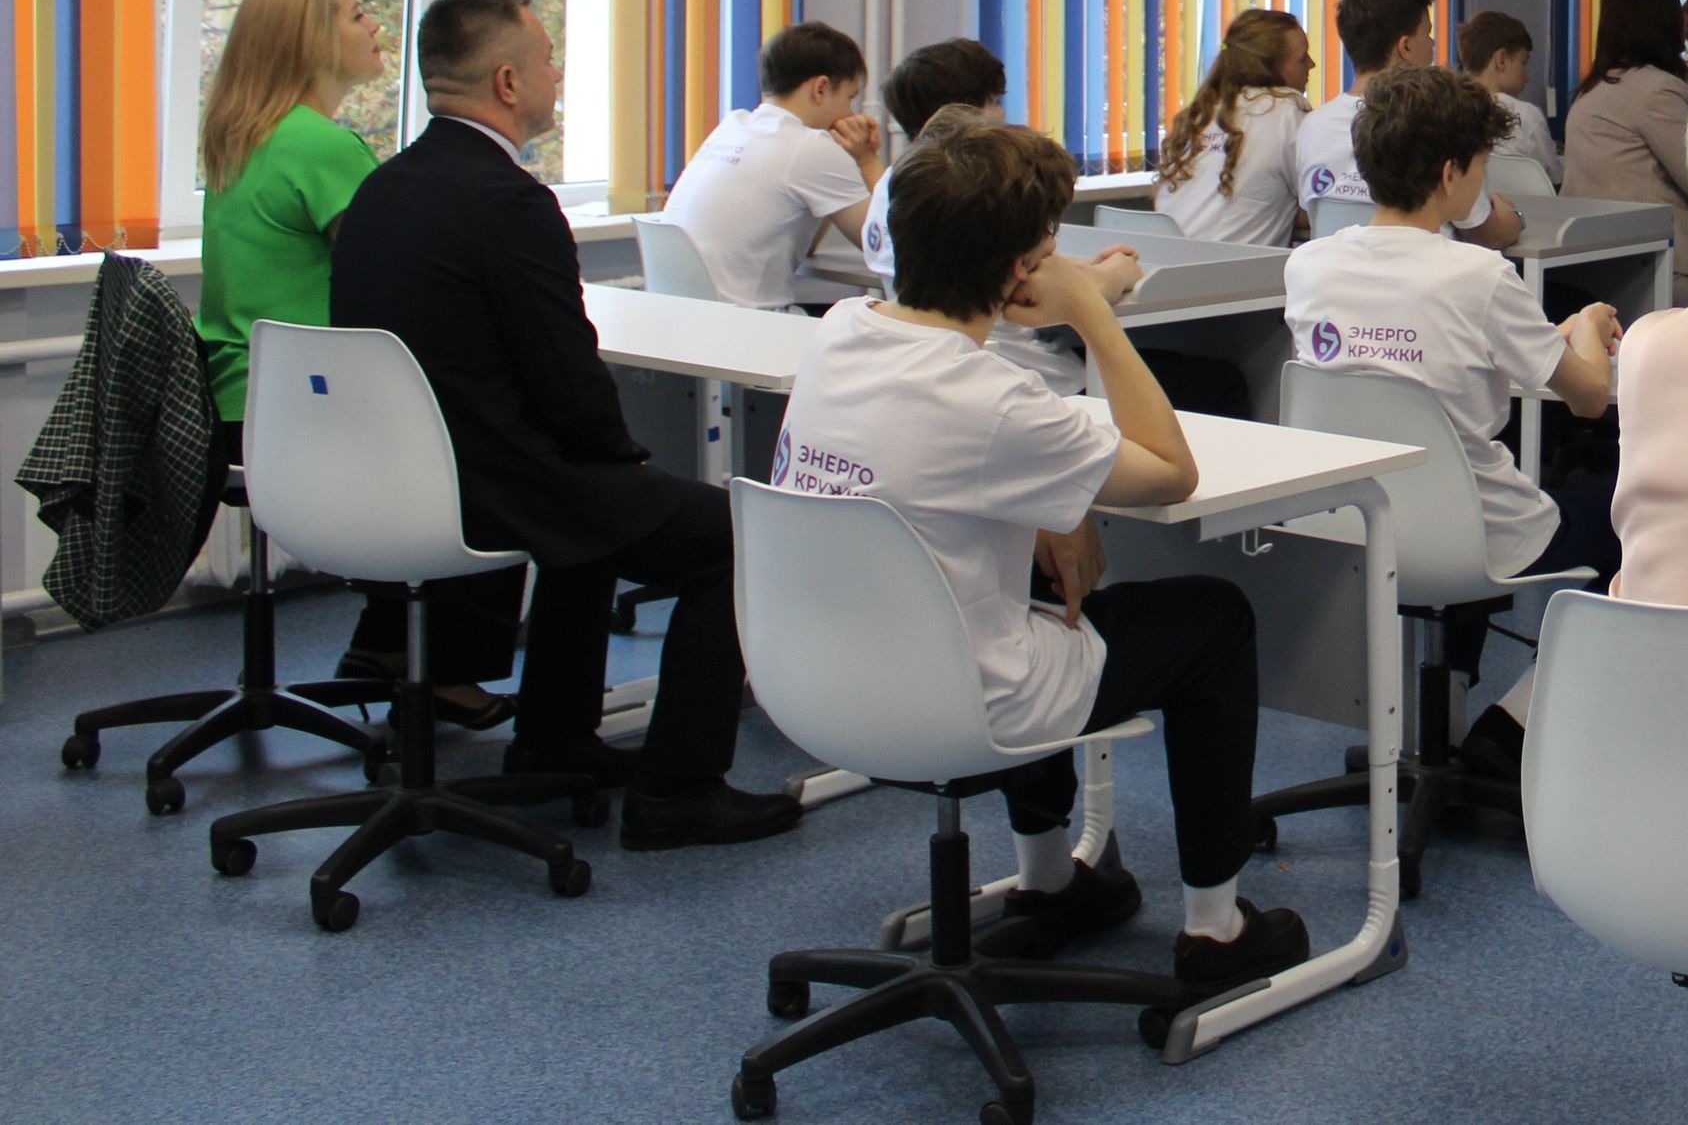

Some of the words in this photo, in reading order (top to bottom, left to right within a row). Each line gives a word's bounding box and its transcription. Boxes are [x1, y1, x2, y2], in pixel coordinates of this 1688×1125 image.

[1348, 326, 1417, 343] ЭНЕРГО
[1347, 344, 1423, 363] КРУЖКИ
[797, 444, 874, 486] ЭНЕРГО
